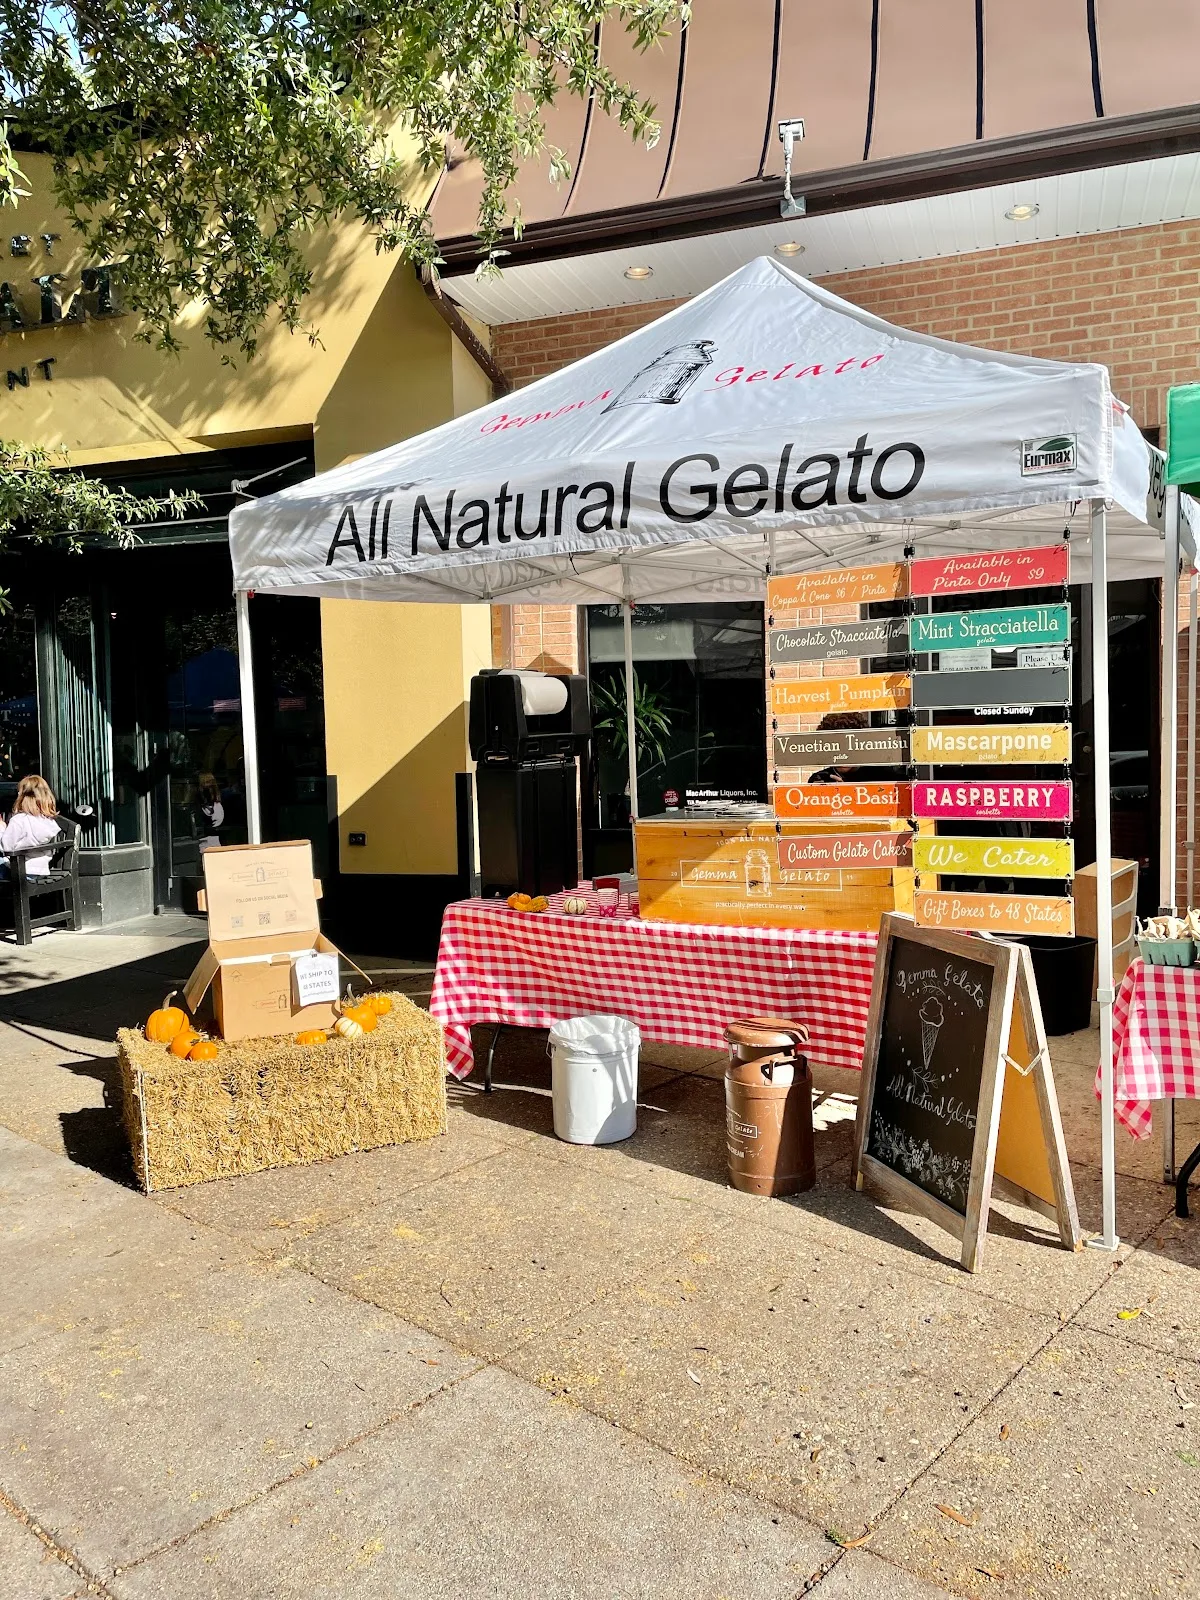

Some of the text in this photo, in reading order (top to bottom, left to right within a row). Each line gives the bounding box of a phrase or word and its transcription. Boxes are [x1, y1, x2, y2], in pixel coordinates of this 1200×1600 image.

[478, 354, 885, 438] Gemma Gelato
[1024, 450, 1071, 468] Eurmax
[325, 432, 926, 566] All Natural Gelato
[943, 554, 1034, 574] Available in
[796, 571, 876, 591] Available in
[933, 568, 1045, 591] Pinta Only $9
[772, 593, 800, 608] Coppa
[835, 588, 847, 598] $6
[861, 584, 887, 597] Pinta
[918, 611, 1060, 641] Mint Stracciatella
[775, 624, 903, 652] Chocolate Stracciatella
[976, 636, 997, 647] gelato
[826, 648, 849, 658] gelato
[1025, 655, 1048, 663] Please
[775, 683, 907, 705] Harvest Pumpkin
[974, 705, 1035, 717] Closed Sunday
[777, 734, 909, 754] Venetian Tiramisu
[926, 731, 1053, 755] Mascarpone
[978, 752, 998, 762] gelato
[720, 789, 746, 798] Liquors,
[785, 786, 901, 809] Orange Basil
[926, 787, 1055, 808] RASPBERRY
[787, 838, 908, 863] Custom Gelato Cakes
[927, 844, 1056, 868] We Cater
[690, 867, 830, 888] Gemma Gelato
[923, 898, 1063, 923] Gift Boxes to 48 States
[308, 971, 323, 979] SHIP
[308, 980, 332, 989] STATES
[896, 961, 985, 1010] Gemma Gelato
[886, 1074, 904, 1100] All
[905, 1082, 946, 1119] Natural
